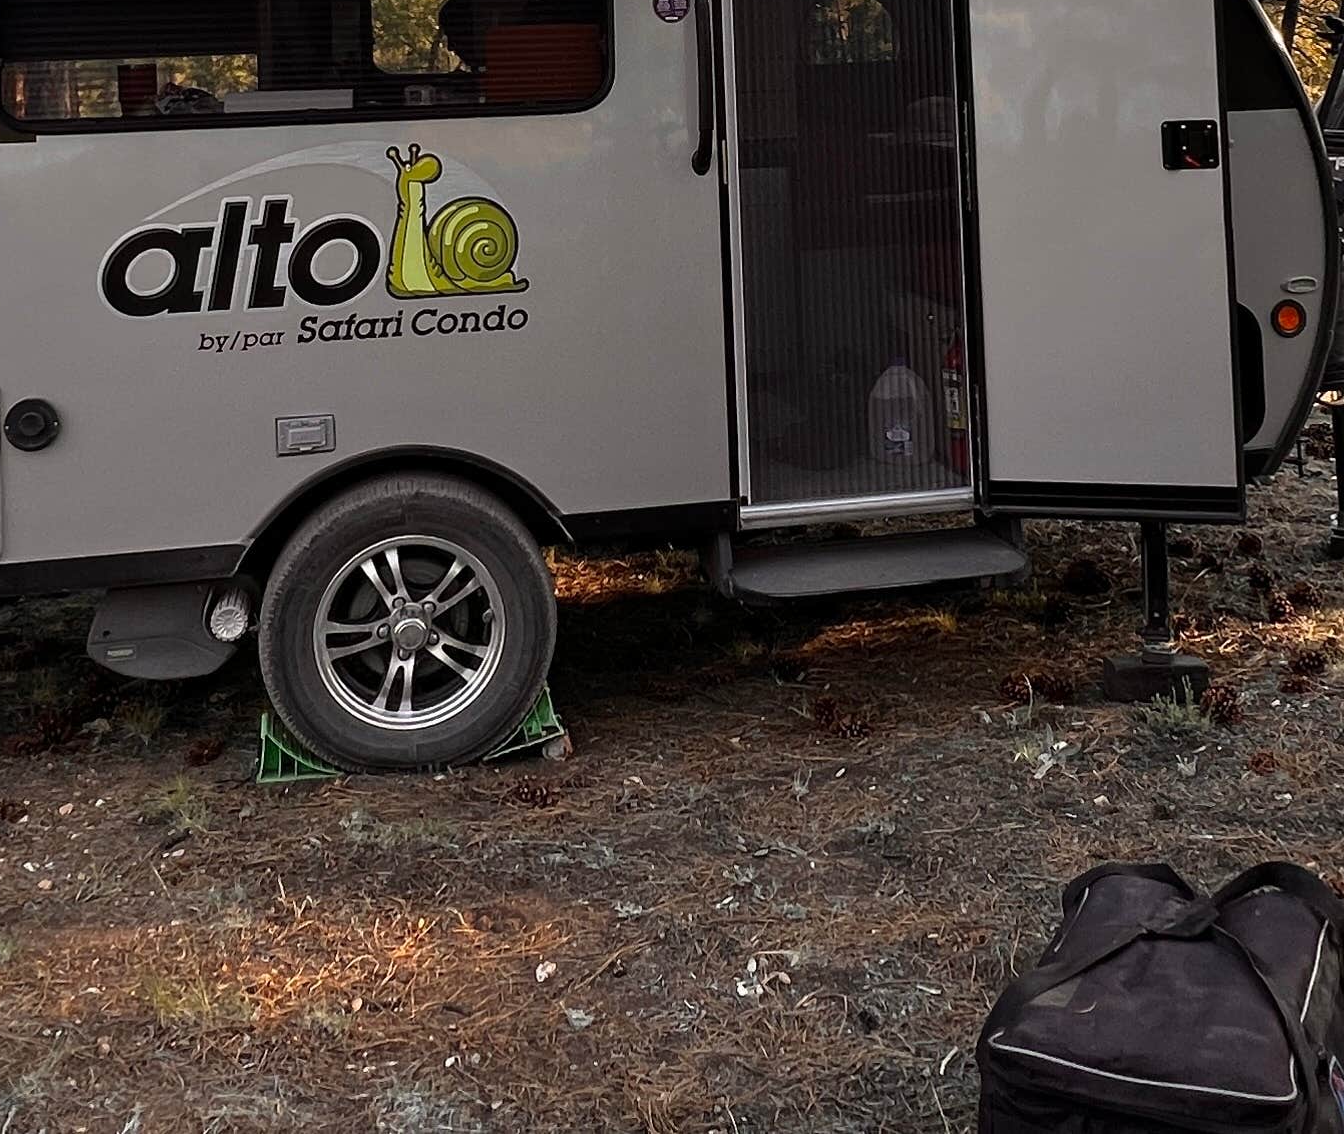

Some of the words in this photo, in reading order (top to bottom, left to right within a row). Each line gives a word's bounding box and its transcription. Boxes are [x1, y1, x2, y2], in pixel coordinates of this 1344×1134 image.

[101, 198, 382, 317] alto
[198, 330, 286, 353] by/par
[297, 310, 404, 344] Safari
[411, 304, 529, 336] Condo
